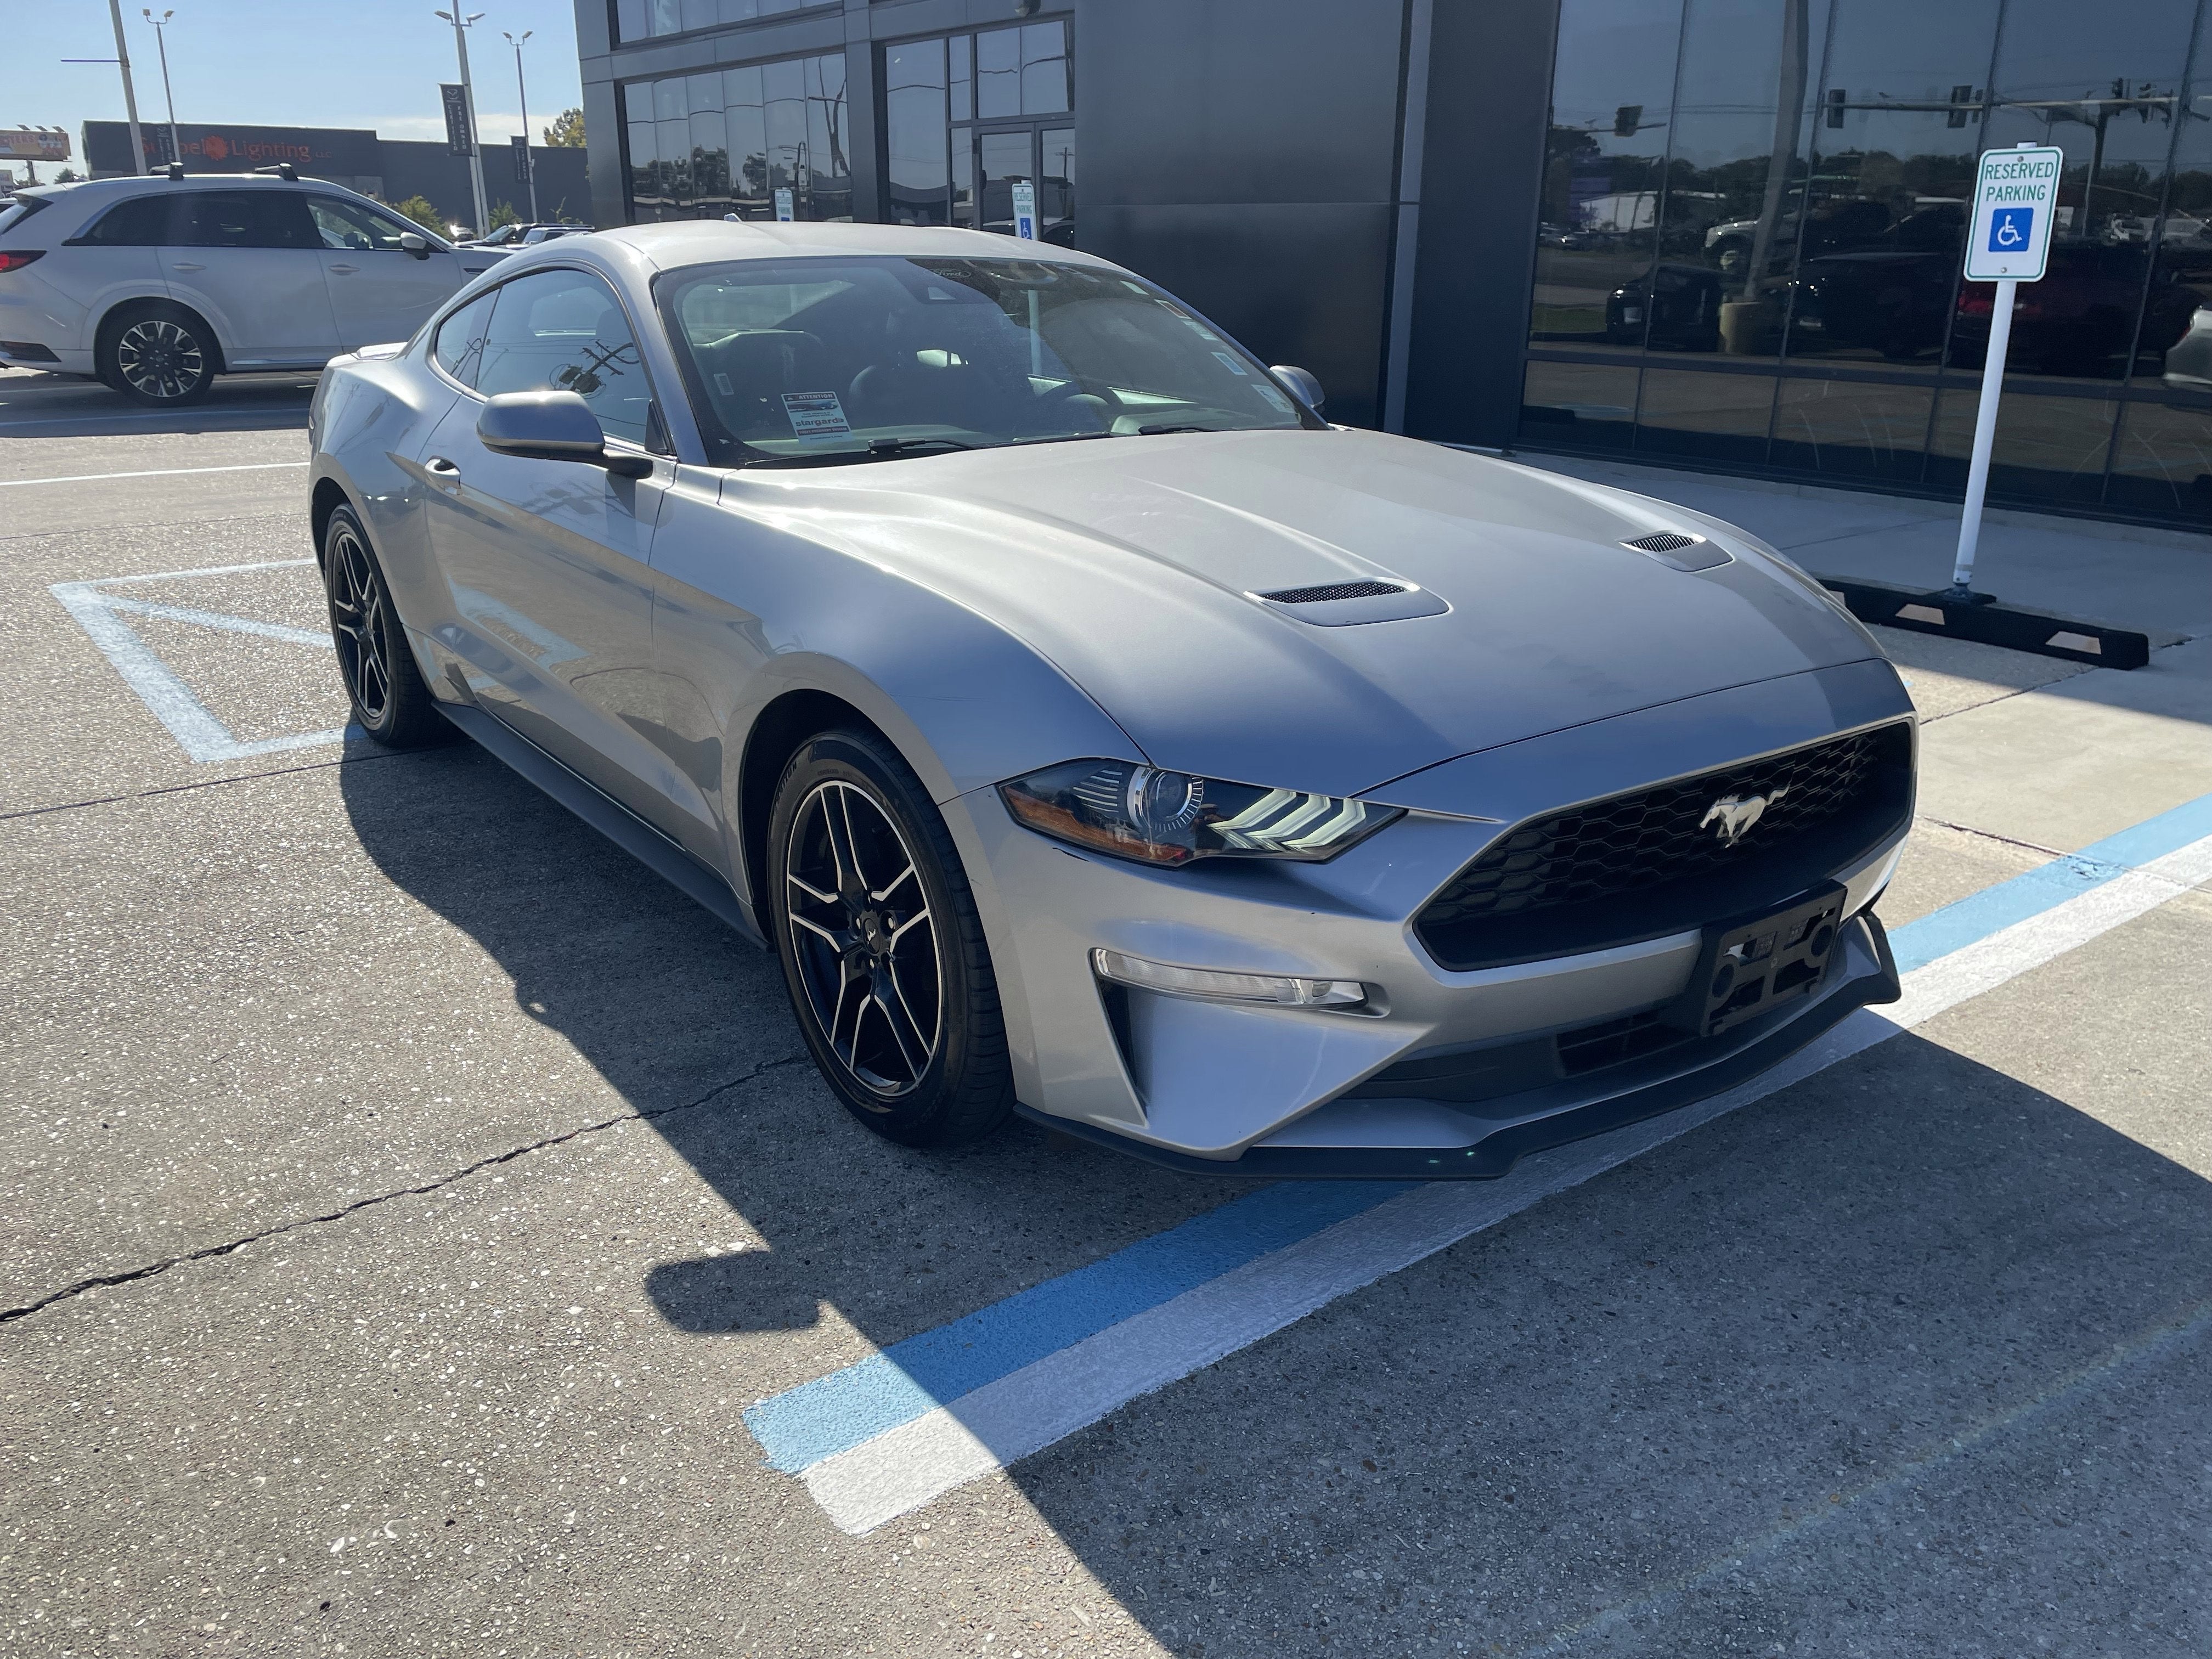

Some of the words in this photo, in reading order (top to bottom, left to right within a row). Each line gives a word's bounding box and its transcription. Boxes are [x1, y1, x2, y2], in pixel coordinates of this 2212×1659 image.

[231, 139, 312, 163] Lighting
[1984, 162, 2054, 179] RESERVED
[1986, 185, 2046, 201] PARKING
[795, 417, 838, 426] stargard
